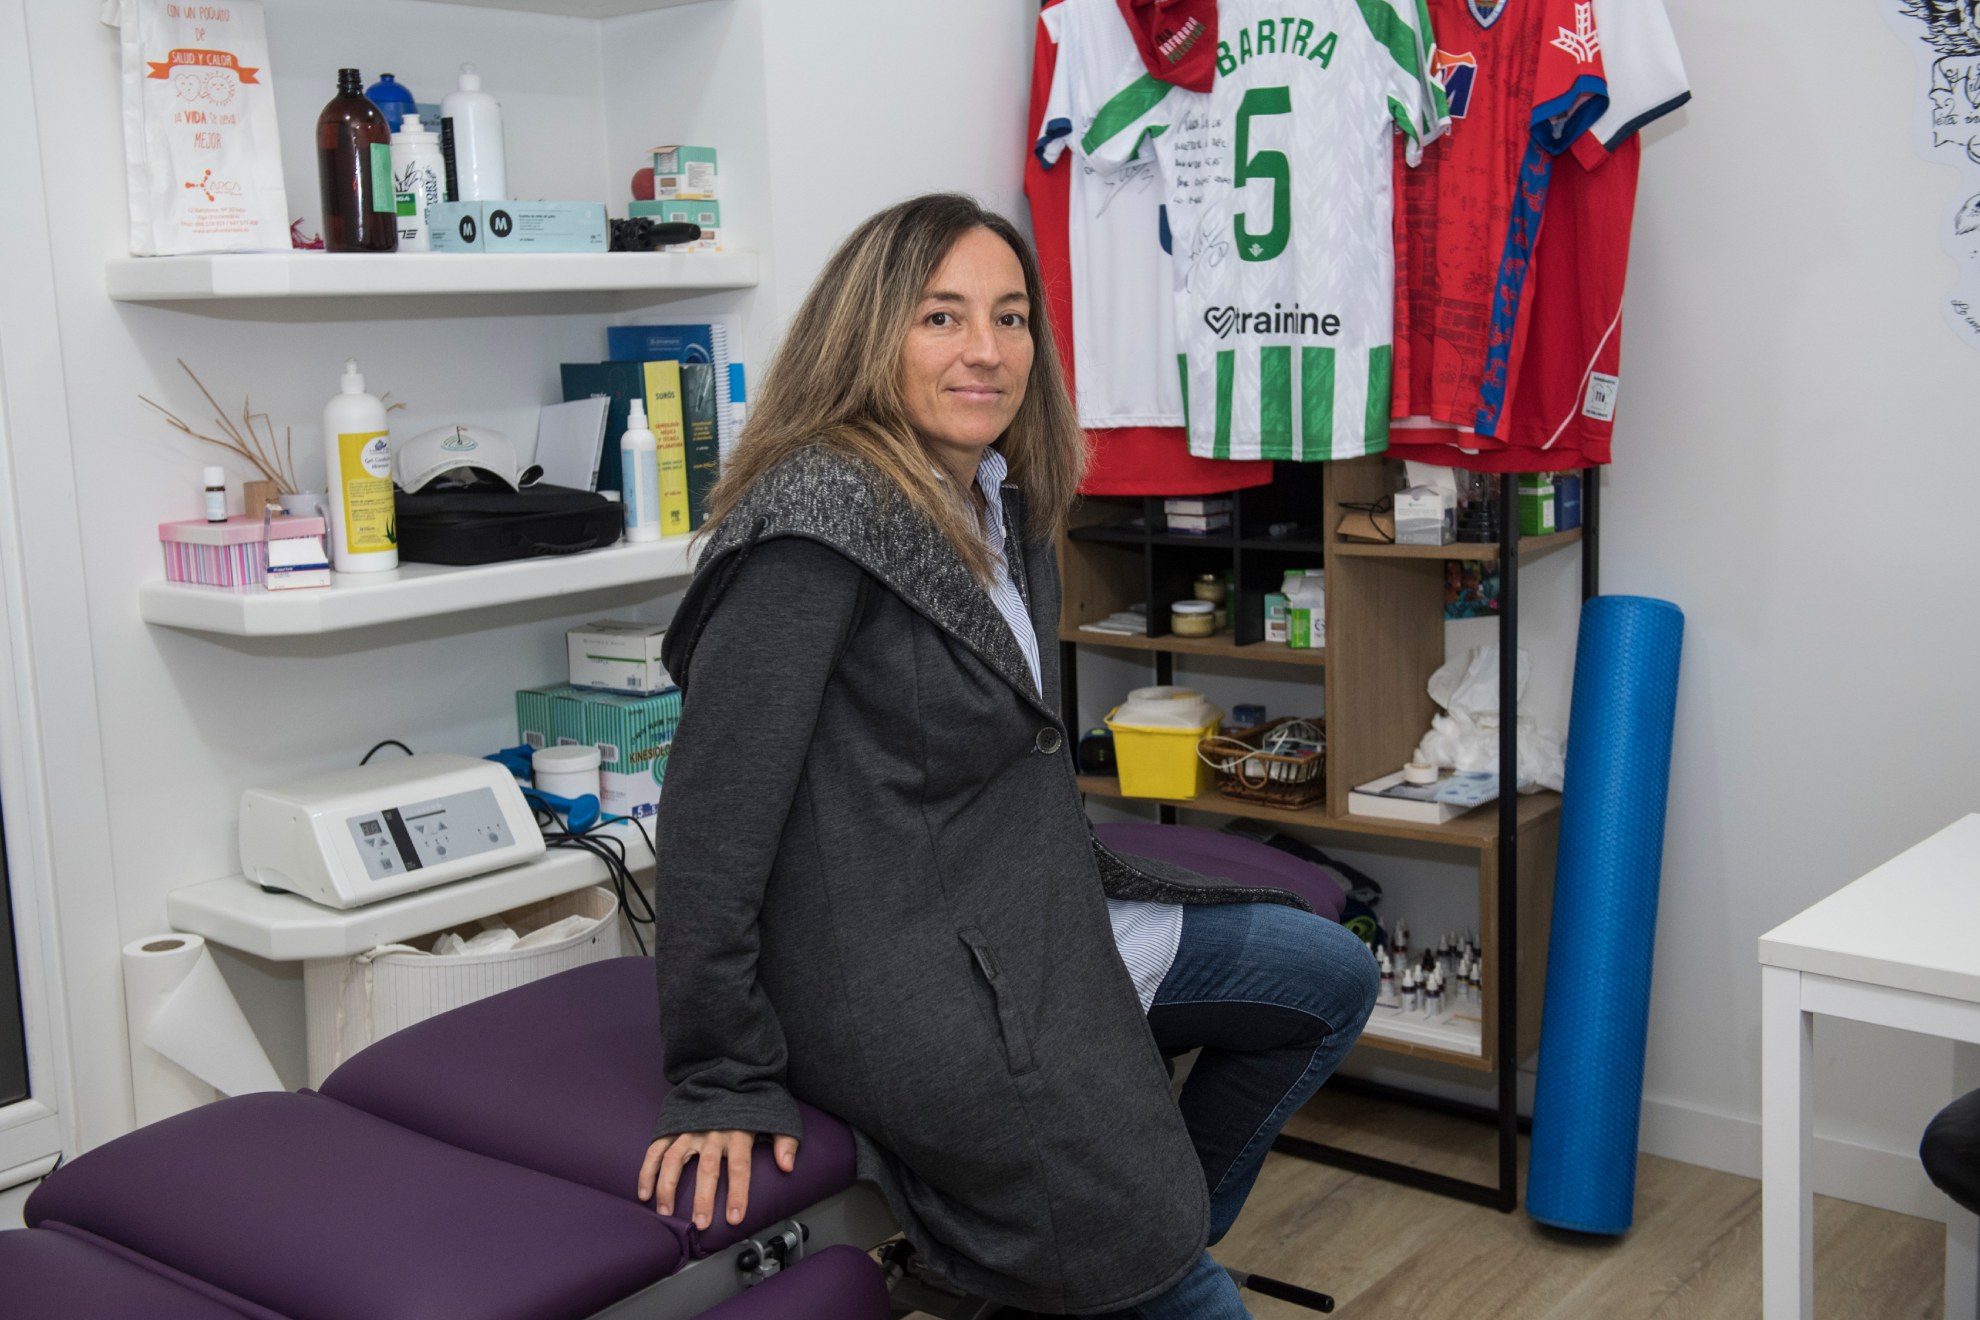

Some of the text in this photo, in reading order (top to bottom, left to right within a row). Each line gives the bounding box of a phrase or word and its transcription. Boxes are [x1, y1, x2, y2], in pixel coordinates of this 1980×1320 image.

[1216, 17, 1338, 78] BARTRA
[171, 51, 232, 66] SALUD Y CALOR
[184, 110, 207, 124] VIDA
[194, 131, 222, 149] MEJOR
[1233, 85, 1292, 262] 5
[463, 222, 473, 237] M
[495, 216, 508, 231] M
[629, 744, 673, 764] KINESIOLO
